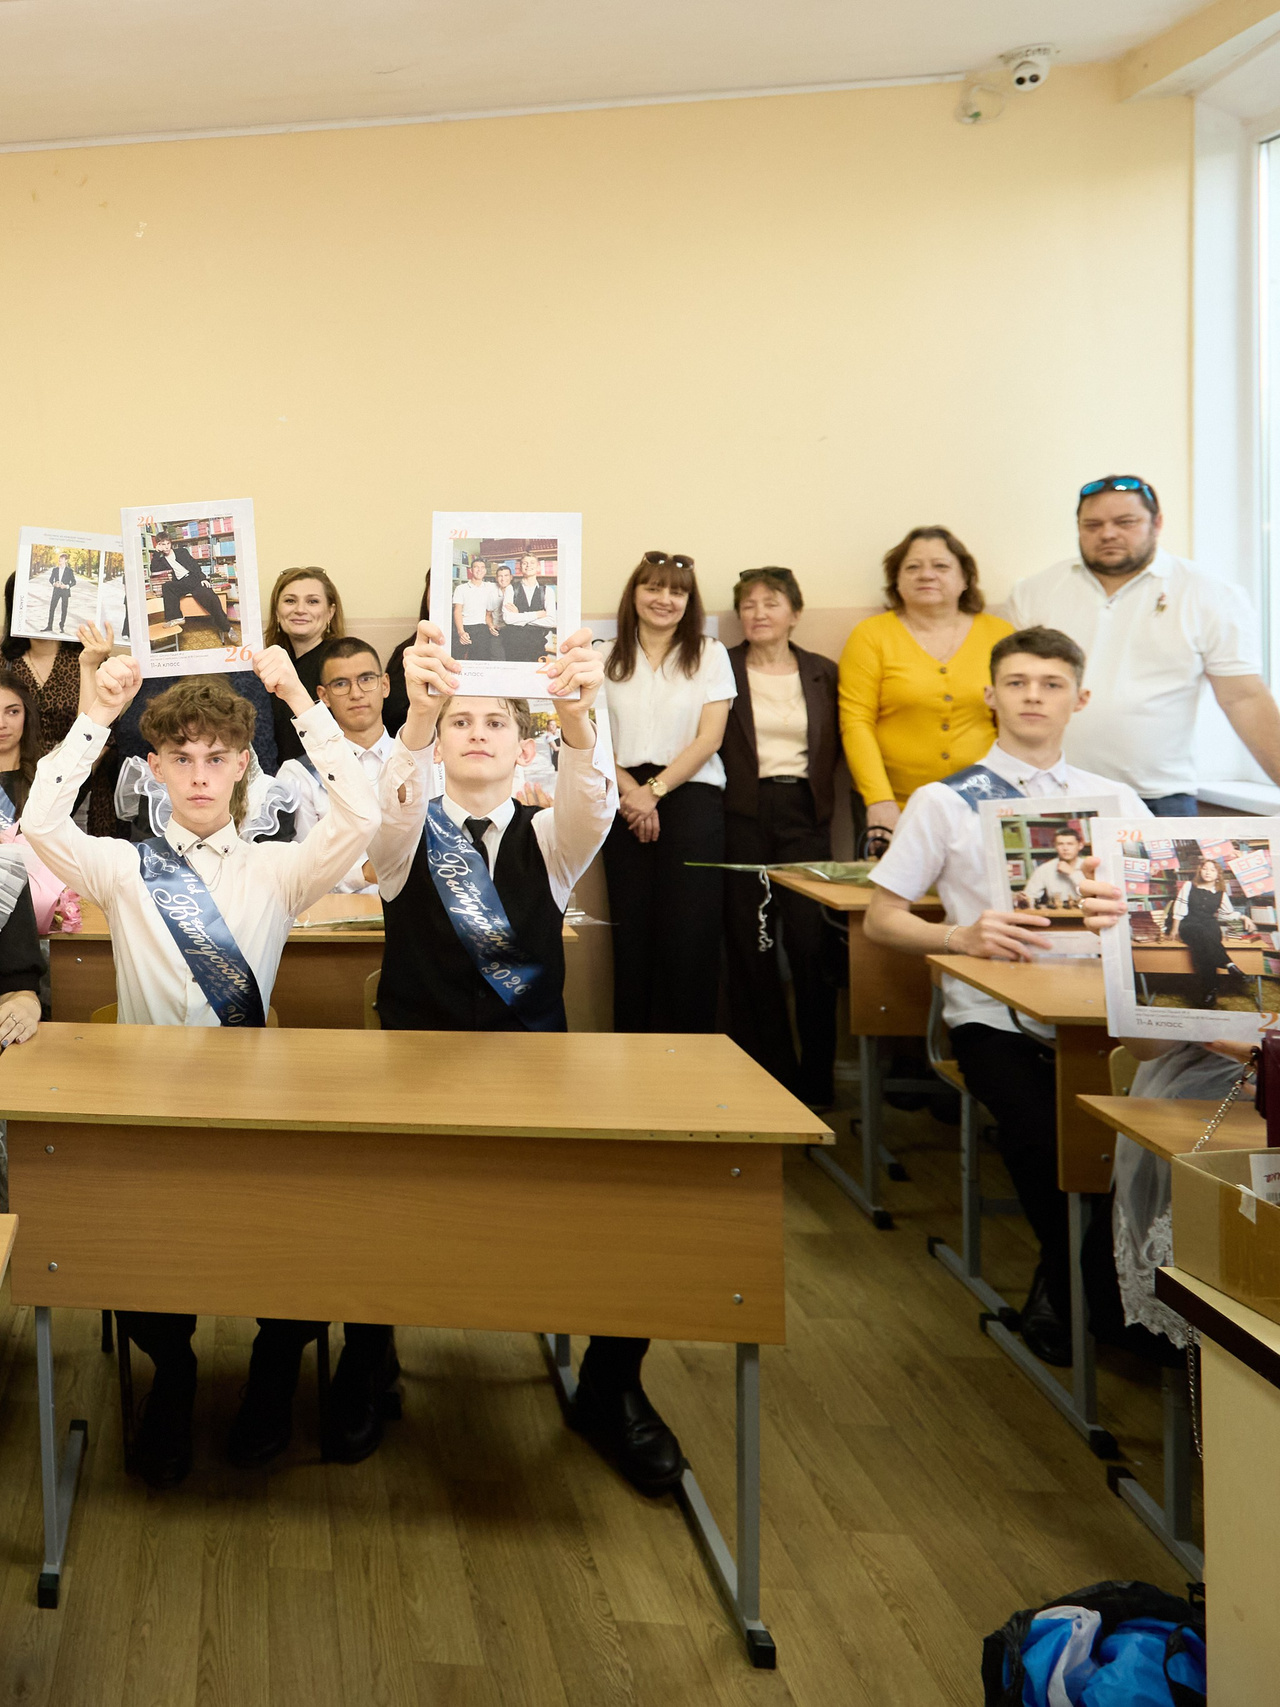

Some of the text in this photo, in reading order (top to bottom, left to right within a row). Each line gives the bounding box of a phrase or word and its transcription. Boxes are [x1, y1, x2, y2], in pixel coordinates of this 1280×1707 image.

[137, 515, 155, 528] 20
[449, 528, 469, 540] 20
[224, 643, 253, 663] 26
[162, 660, 180, 668] класс
[1116, 829, 1143, 843] 20
[1124, 861, 1148, 871] ЕГЭ
[1238, 854, 1267, 871] ЕГЭ
[180, 872, 206, 895] 11А
[481, 961, 533, 996] 2026
[1155, 1021, 1184, 1029] класс
